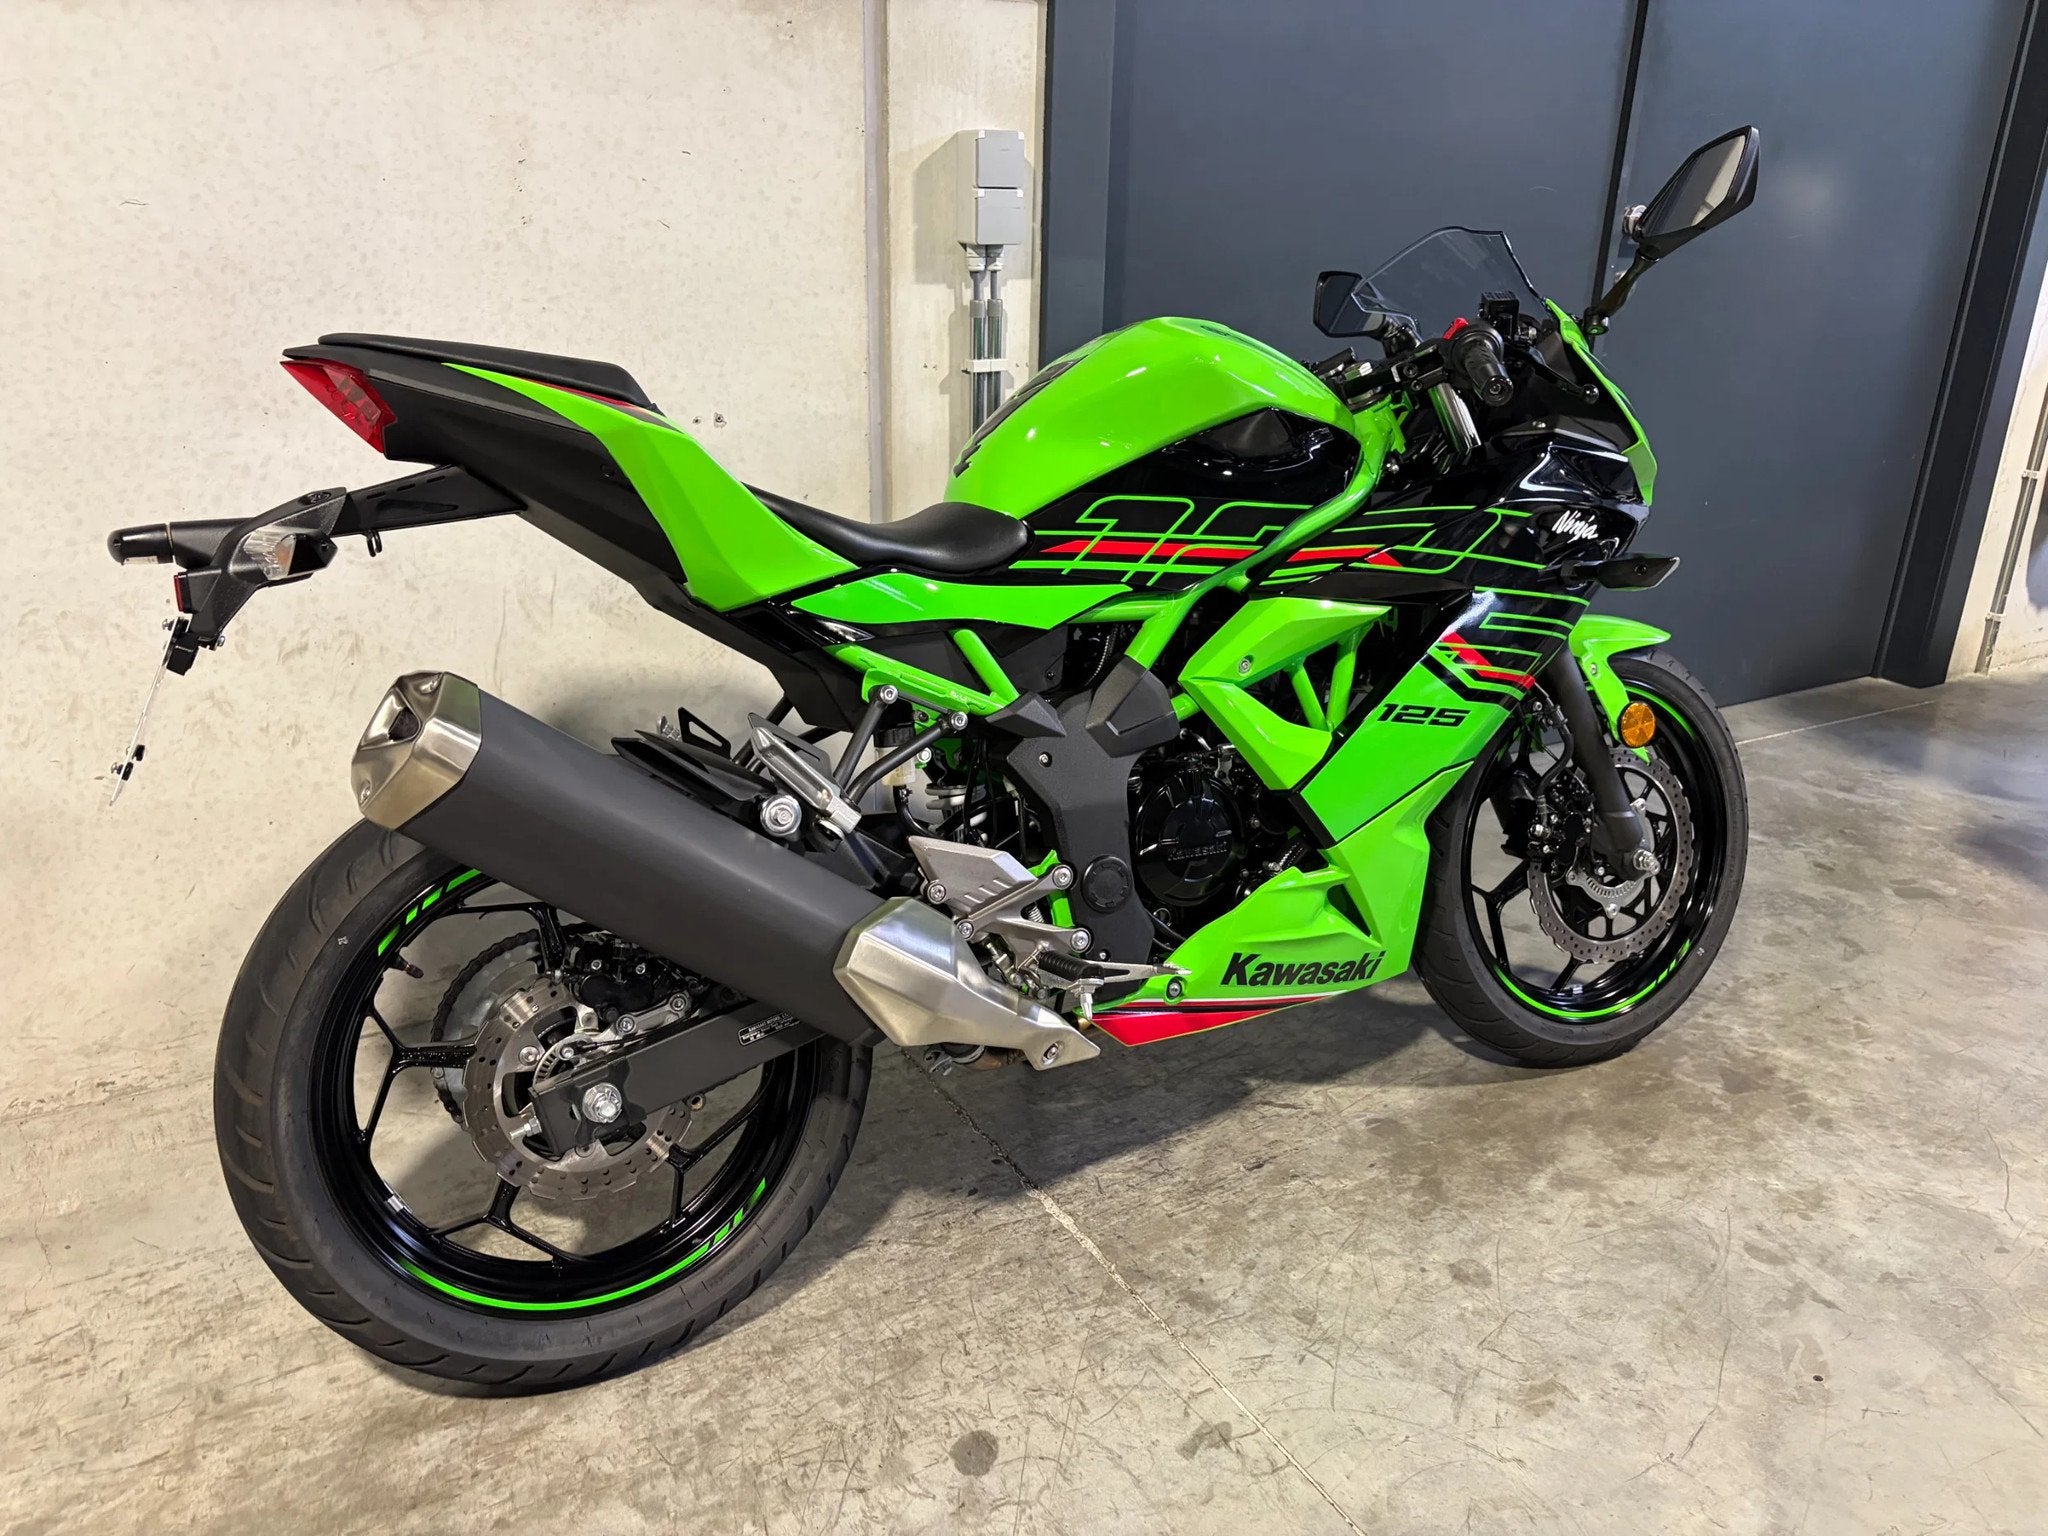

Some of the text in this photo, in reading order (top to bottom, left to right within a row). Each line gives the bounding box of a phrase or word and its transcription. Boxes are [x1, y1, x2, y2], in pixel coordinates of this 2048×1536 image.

[1551, 510, 1599, 544] Ninja
[1377, 703, 1472, 727] 125
[1220, 950, 1387, 987] Kawasaki
